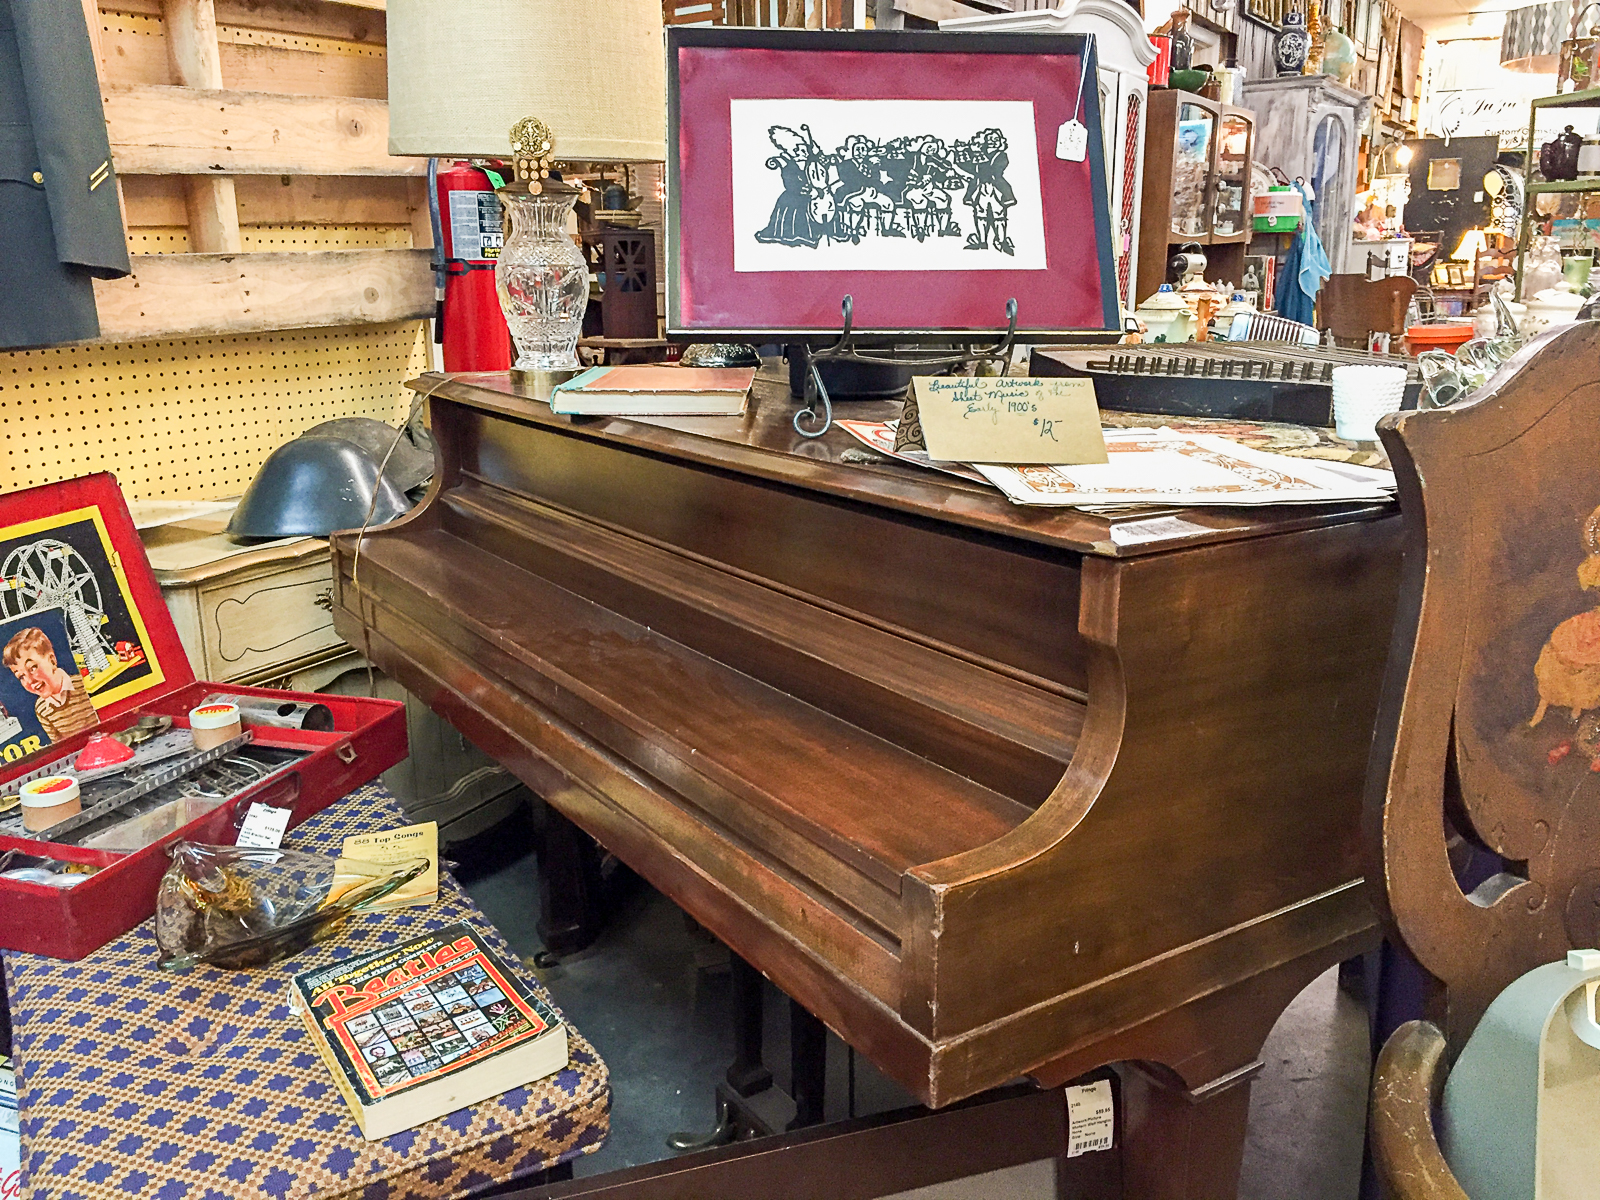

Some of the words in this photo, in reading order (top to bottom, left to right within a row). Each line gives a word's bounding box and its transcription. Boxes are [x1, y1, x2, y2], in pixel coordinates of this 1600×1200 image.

[929, 378, 988, 394] Beautiful
[952, 390, 983, 403] Sheet
[985, 389, 1029, 404] Music
[1035, 390, 1045, 400] of
[963, 402, 1000, 425] Early
[1007, 401, 1037, 413] 1900's
[394, 831, 424, 840] Songs
[310, 981, 334, 998] All
[335, 952, 401, 983] Together
[401, 936, 435, 954] Now
[370, 962, 398, 979] FIRST
[398, 941, 444, 965] COMPLETE
[310, 935, 478, 1018] Beatles
[380, 964, 445, 998] DISCOGRAPHY
